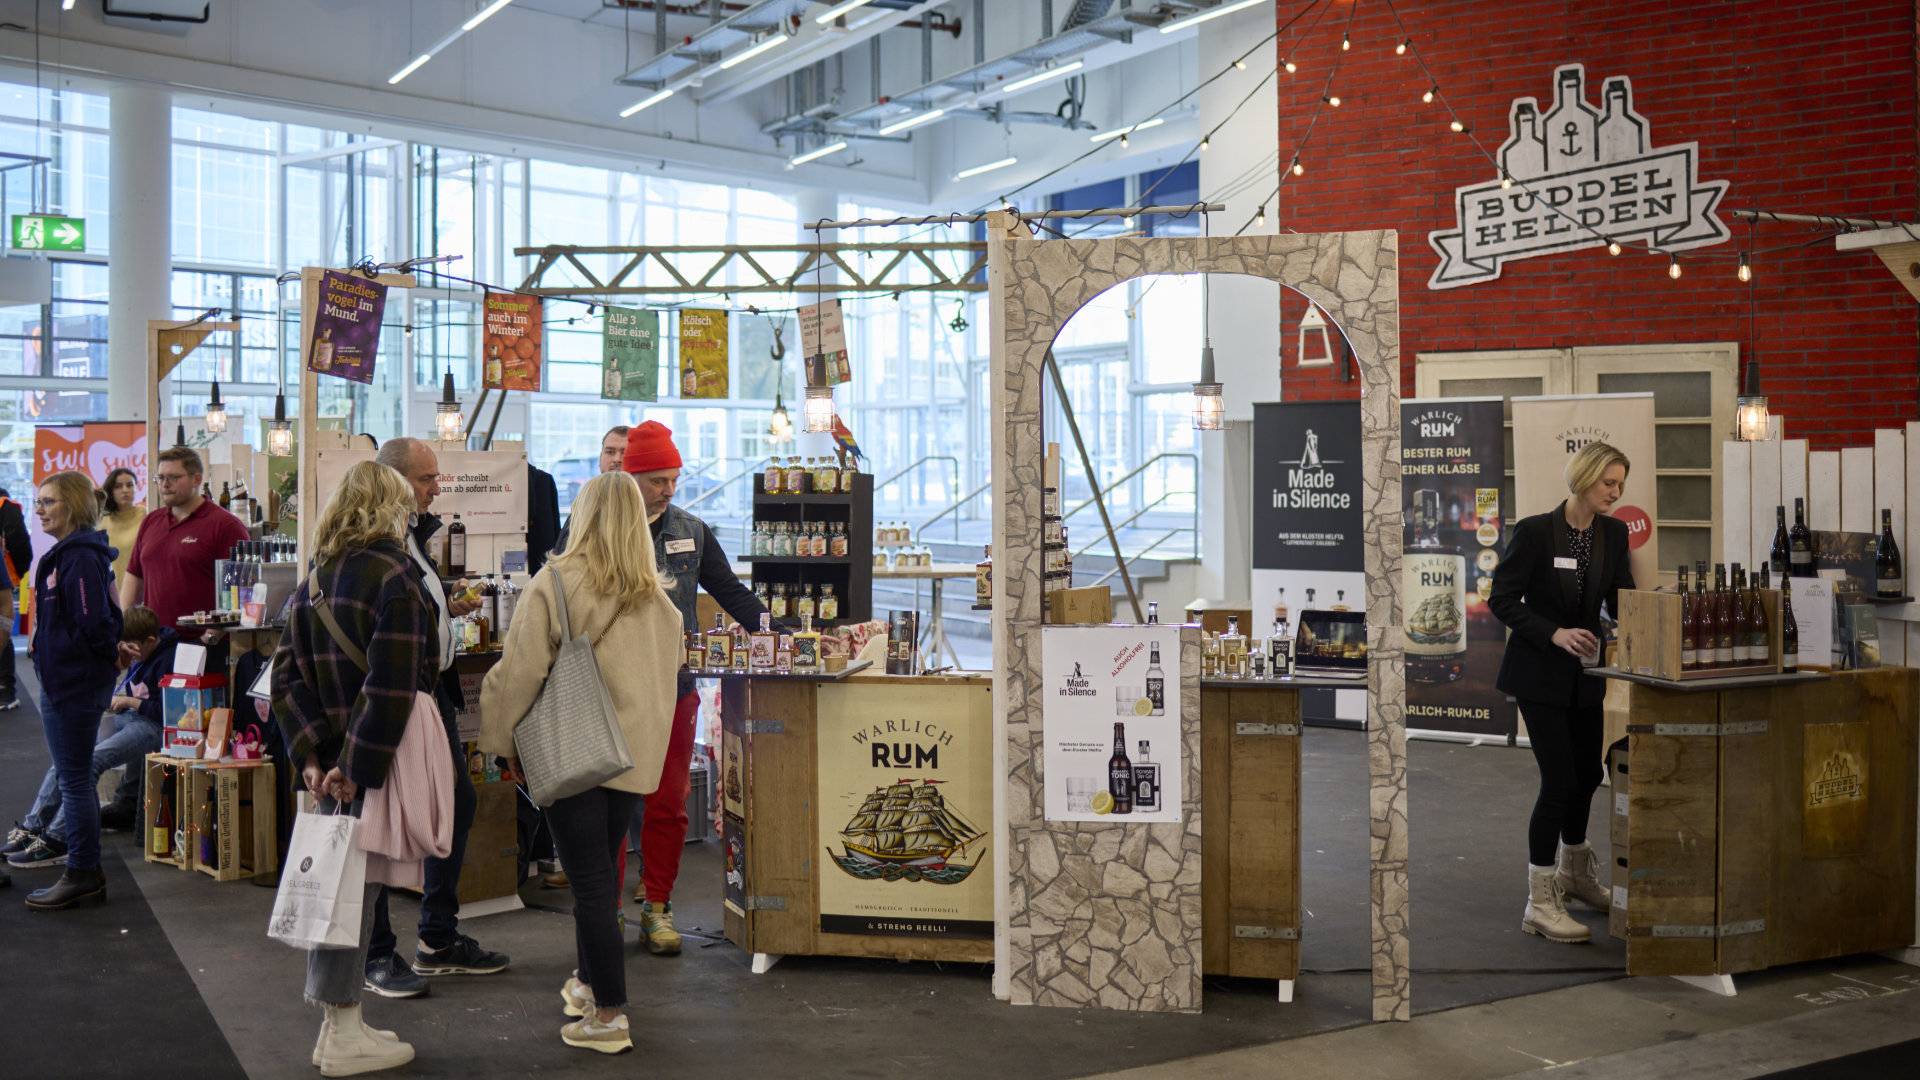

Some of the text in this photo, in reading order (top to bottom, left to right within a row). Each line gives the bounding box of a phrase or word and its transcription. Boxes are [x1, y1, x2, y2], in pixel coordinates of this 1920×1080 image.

[1476, 168, 1673, 221] BUDDEL
[1475, 193, 1677, 247] HELDEN
[328, 277, 380, 300] Paradies-
[327, 292, 374, 313] vogel im
[487, 298, 529, 312] Sommer
[324, 304, 360, 323] Mund.
[487, 311, 528, 325] auch im
[608, 313, 636, 325] Alle 3
[683, 315, 712, 326] Kölsch
[487, 323, 525, 337] Winter!
[608, 325, 650, 338] Bier eine
[683, 329, 702, 337] oder
[608, 339, 654, 350] gute Idee!
[1410, 410, 1464, 427] WARLICH
[1420, 423, 1455, 438] RUM
[1555, 426, 1610, 441] WARLICH
[1403, 447, 1471, 459] BESTER RUM
[1437, 463, 1481, 475] KLASSE
[457, 474, 489, 482] schreibt
[1288, 469, 1335, 489] Made
[454, 484, 464, 492] ab
[466, 484, 487, 492] sofort
[489, 484, 502, 492] mit
[1272, 489, 1351, 509] in Silence
[1625, 518, 1647, 535] EU!
[1410, 557, 1460, 574] WARLICH
[1420, 572, 1454, 587] RUM
[1111, 641, 1145, 677] ALKOHOLFREI
[1113, 646, 1129, 663] AUCH
[1066, 678, 1089, 687] Made
[1059, 688, 1097, 696] in Silence
[1403, 705, 1490, 720] ARLICH-RUM.DE
[852, 718, 955, 747] WARLICH
[871, 742, 938, 769] RUM
[877, 923, 913, 931] STRENG
